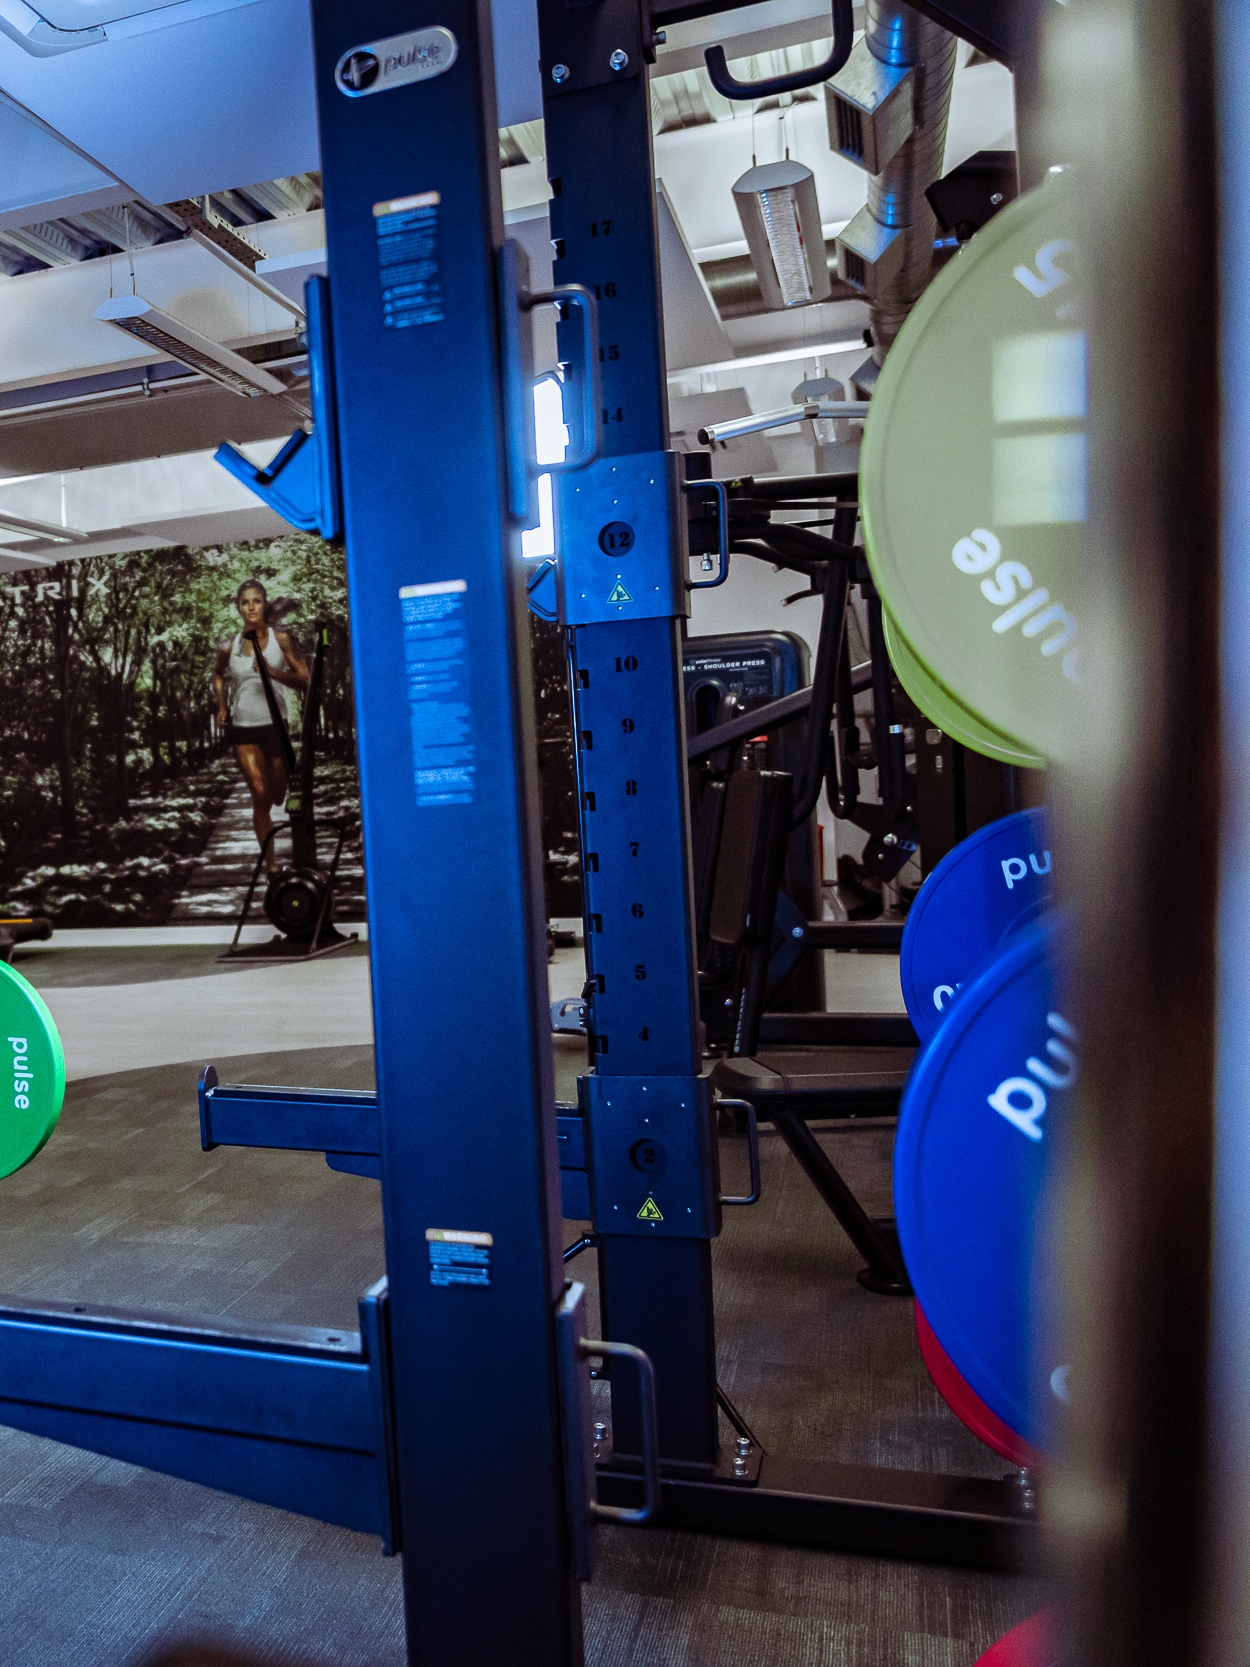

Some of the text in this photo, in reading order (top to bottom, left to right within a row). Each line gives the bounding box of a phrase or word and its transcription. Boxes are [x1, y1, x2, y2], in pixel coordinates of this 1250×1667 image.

[383, 43, 441, 76] pulse
[590, 220, 613, 239] 17
[594, 281, 618, 301] 16
[598, 344, 620, 363] 15
[602, 406, 624, 425] 14
[606, 530, 631, 549] 12
[952, 529, 1078, 680] ulse
[614, 655, 638, 673] 10
[682, 664, 696, 672] ESS
[742, 659, 765, 667] PRESS
[621, 718, 635, 734] 9
[624, 780, 638, 796] 8
[628, 841, 640, 857] 7
[631, 902, 644, 919] 6
[634, 964, 647, 980] 5
[637, 1026, 650, 1042] 4
[7, 1036, 34, 1110] pulse
[643, 1148, 656, 1164] 2
